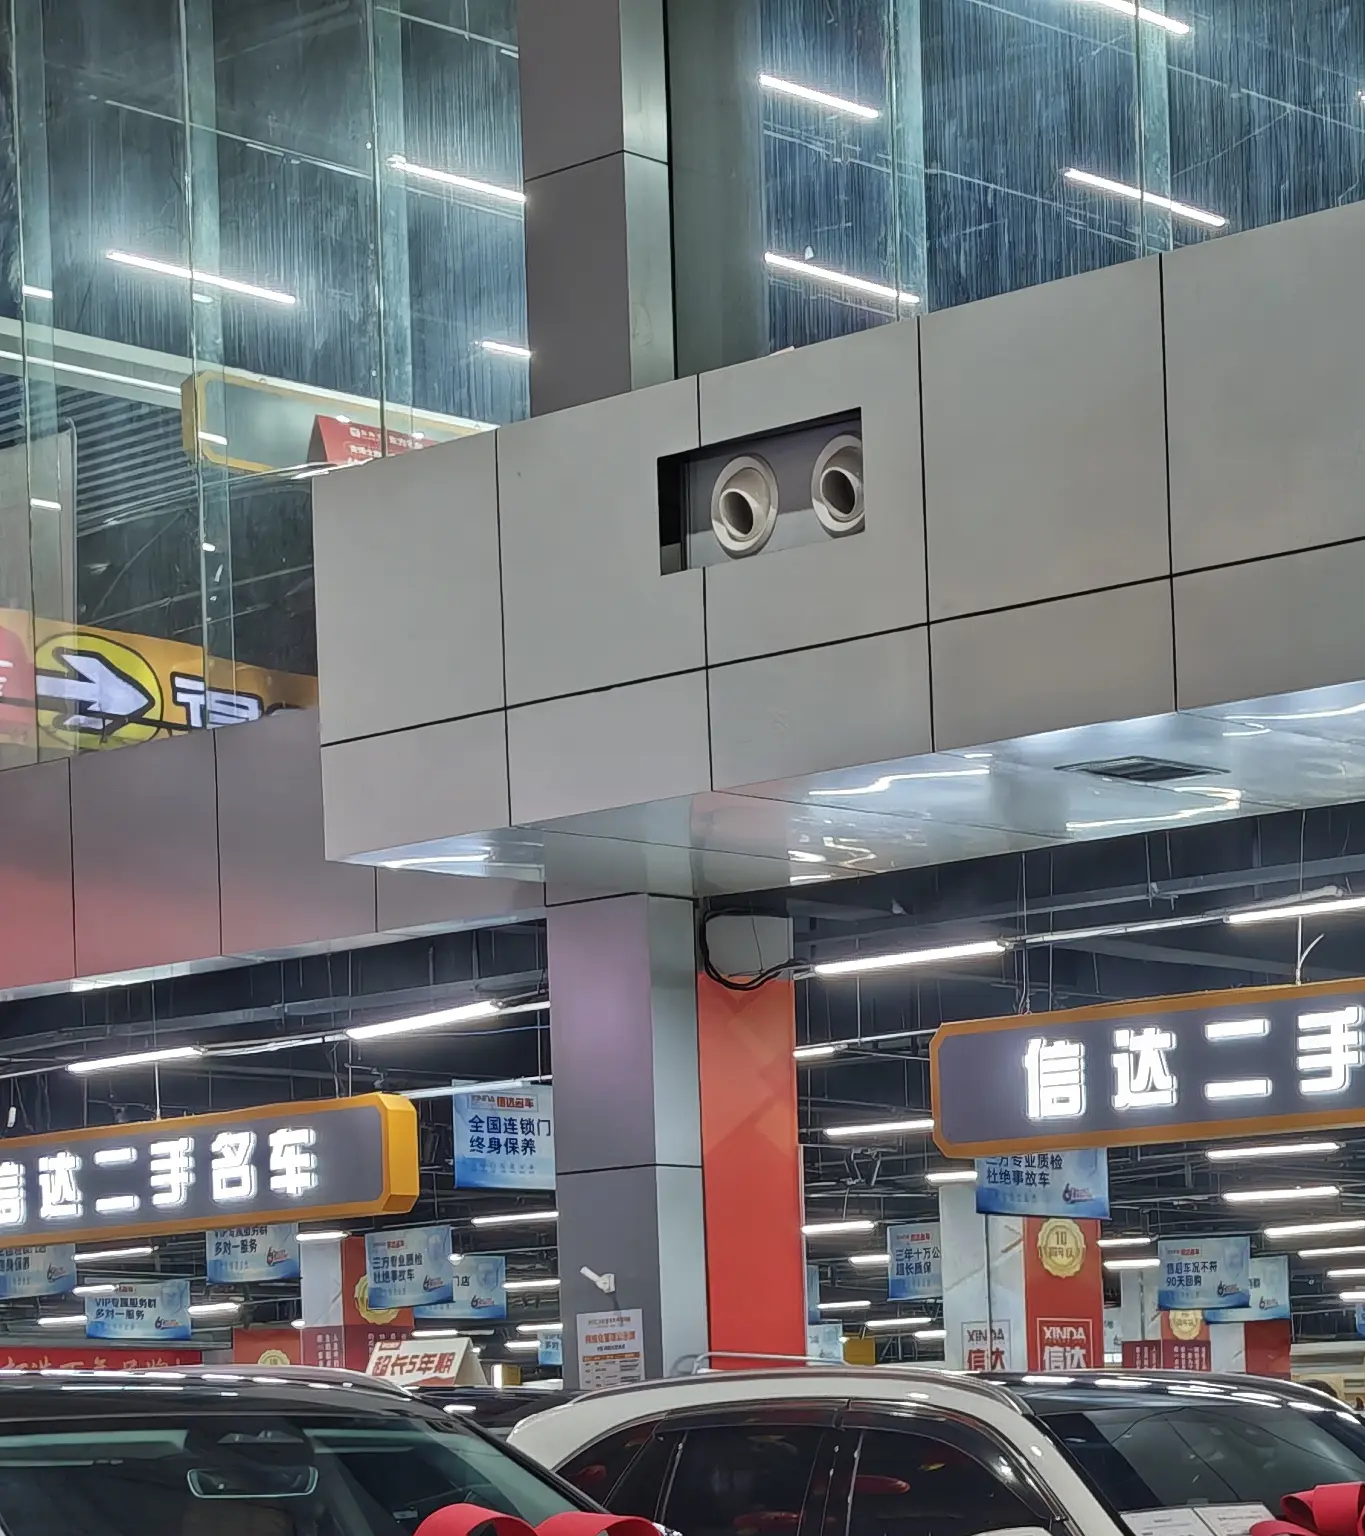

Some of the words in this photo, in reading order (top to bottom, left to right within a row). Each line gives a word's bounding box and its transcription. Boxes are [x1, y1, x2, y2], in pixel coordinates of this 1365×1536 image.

[469, 1135, 537, 1156] 终身保养
[986, 1169, 1051, 1188] 杜绝事故车
[214, 1238, 258, 1256] 多对一服务
[1042, 1325, 1087, 1340] XINDA
